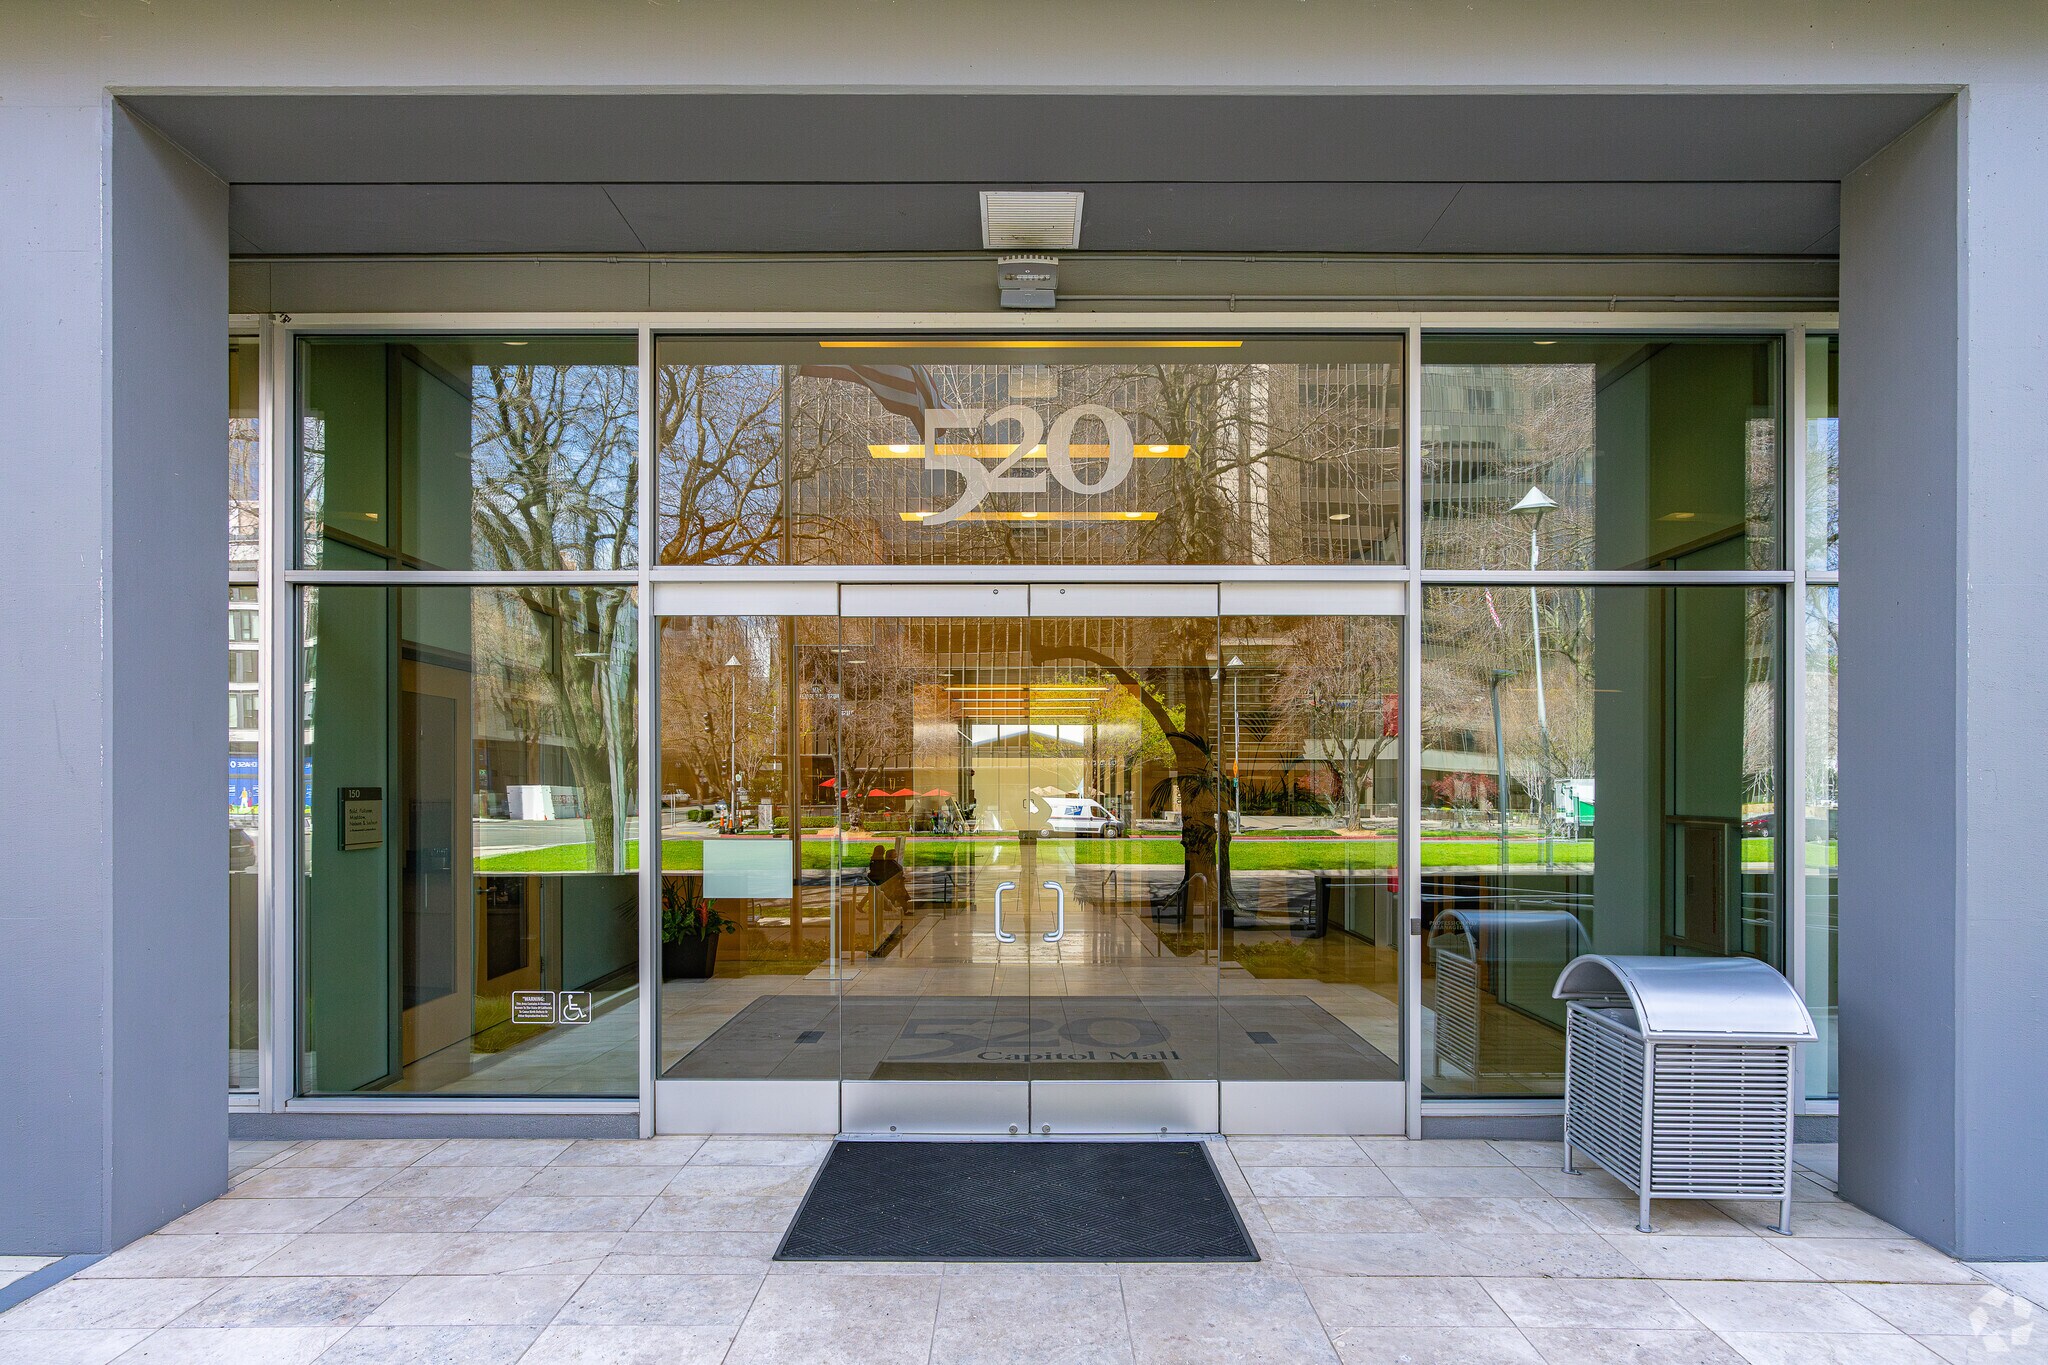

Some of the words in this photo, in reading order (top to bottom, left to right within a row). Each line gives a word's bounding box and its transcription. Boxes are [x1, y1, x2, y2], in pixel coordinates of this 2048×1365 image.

[923, 404, 1134, 525] 520
[348, 789, 361, 798] 150
[888, 1017, 1171, 1060] 520
[977, 1051, 1095, 1062] Capitol
[1110, 1051, 1183, 1061] Mall
